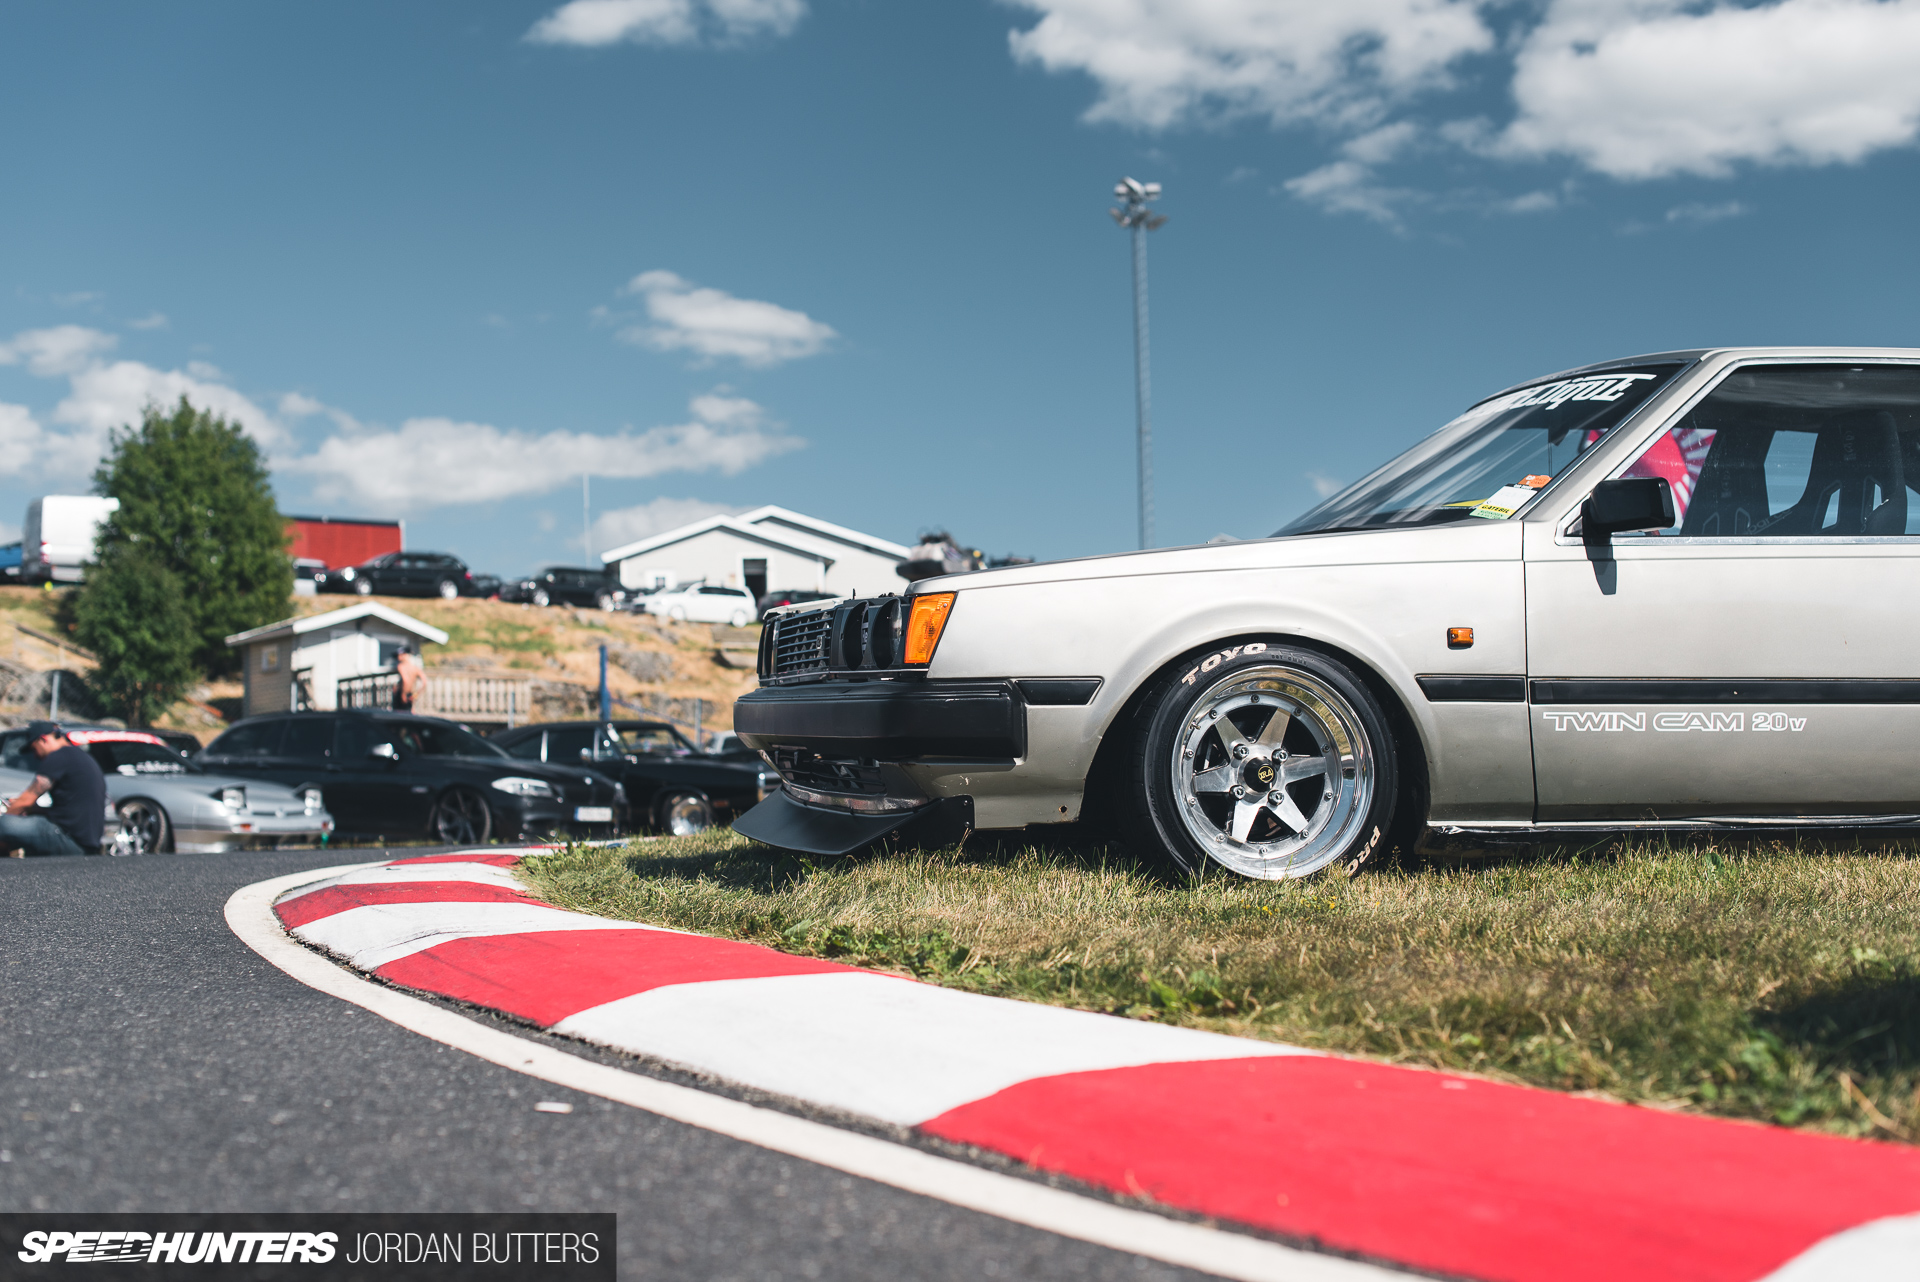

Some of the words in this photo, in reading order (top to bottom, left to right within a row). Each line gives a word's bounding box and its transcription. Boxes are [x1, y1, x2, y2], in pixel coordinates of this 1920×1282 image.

[1182, 642, 1267, 686] TOYO
[1543, 712, 1646, 731] TWIN
[1653, 712, 1744, 731] CAM
